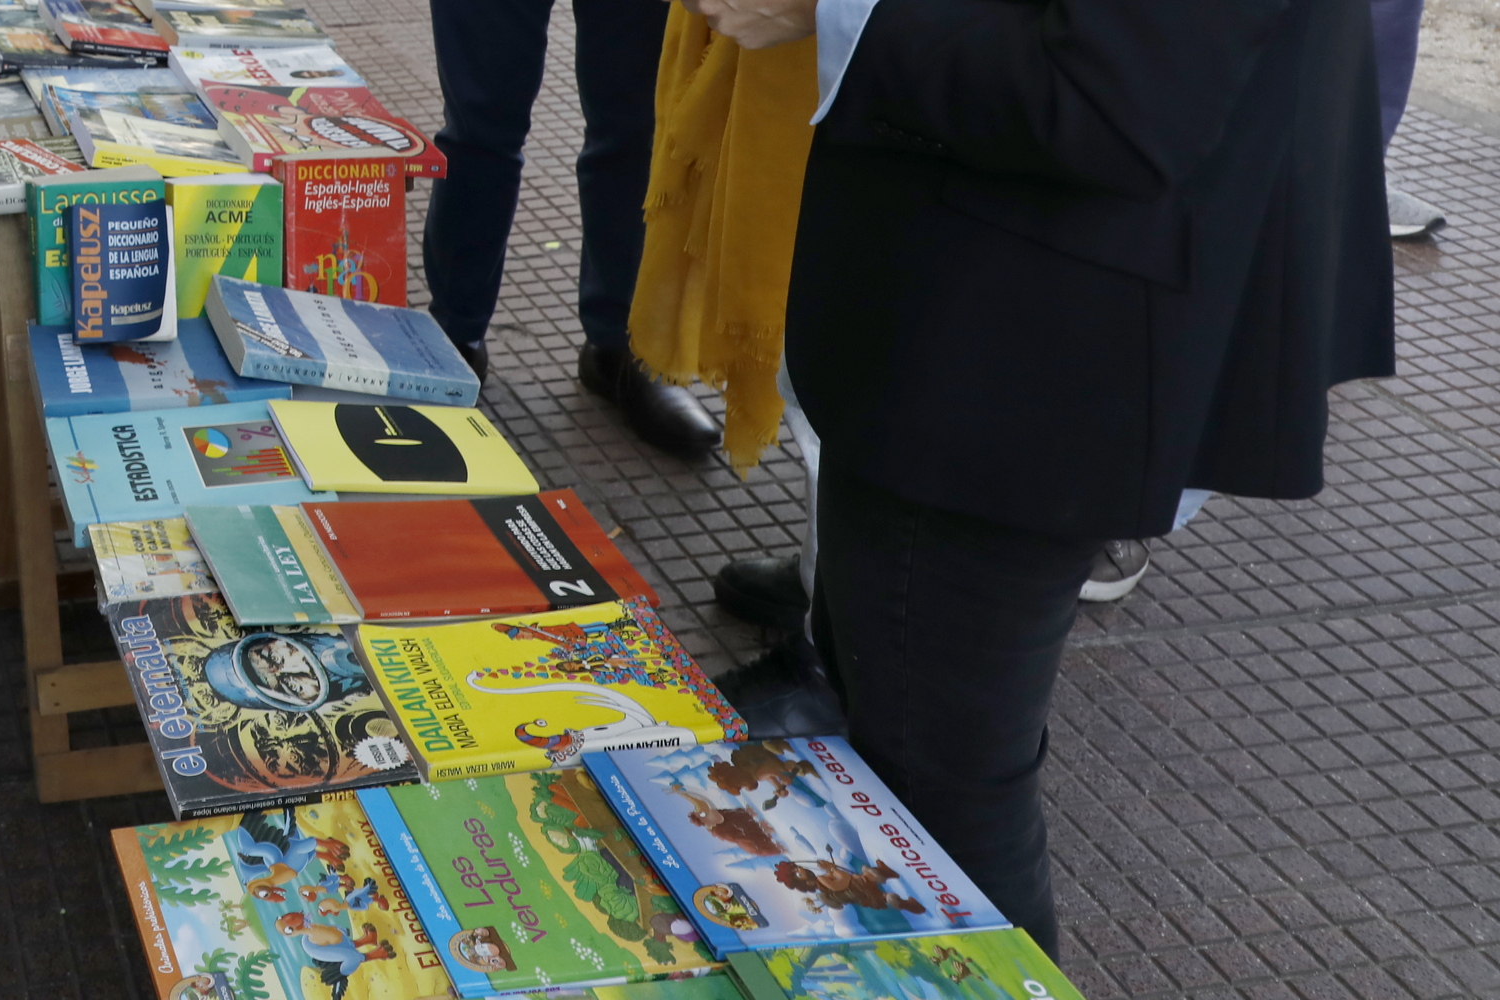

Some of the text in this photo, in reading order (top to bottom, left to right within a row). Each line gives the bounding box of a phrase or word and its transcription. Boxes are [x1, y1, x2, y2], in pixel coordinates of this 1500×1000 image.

[304, 180, 390, 197] Español-Inglés
[206, 199, 254, 209] DICCIONARIO
[304, 195, 391, 214] Inglés-Español
[108, 217, 158, 231] PEQUEÑO
[205, 210, 253, 224] ACME
[108, 231, 159, 247] DICCIONARIO
[184, 231, 274, 245] ESPAÑOL PORTUGUÉS
[108, 247, 159, 264] DE LA LENGUA
[185, 244, 273, 259] PORTUGUÉS ESPAÑOL
[77, 208, 108, 339] Kapelusz
[109, 264, 159, 280] ESPAÑOLA
[110, 302, 152, 316] Kapelusz
[65, 361, 93, 395] JORGE
[255, 362, 334, 380] ARGENTINOS
[346, 374, 438, 394] JORGE LANATA
[111, 424, 159, 503] ESTADISTICA
[517, 504, 541, 532] EMPRESA
[272, 543, 318, 606] LA LEY
[548, 578, 596, 598] 2
[119, 613, 208, 778] el eternauta
[370, 637, 445, 753] DAILAN KIFKI
[400, 637, 479, 750] MARIA ELENA WALSH
[436, 759, 516, 778] MARIA ELENA WALSH
[283, 795, 308, 806] héctor
[806, 740, 973, 926] Técnicas de caza
[451, 855, 495, 909] Las
[463, 817, 548, 944] verduras
[419, 945, 442, 971] El
